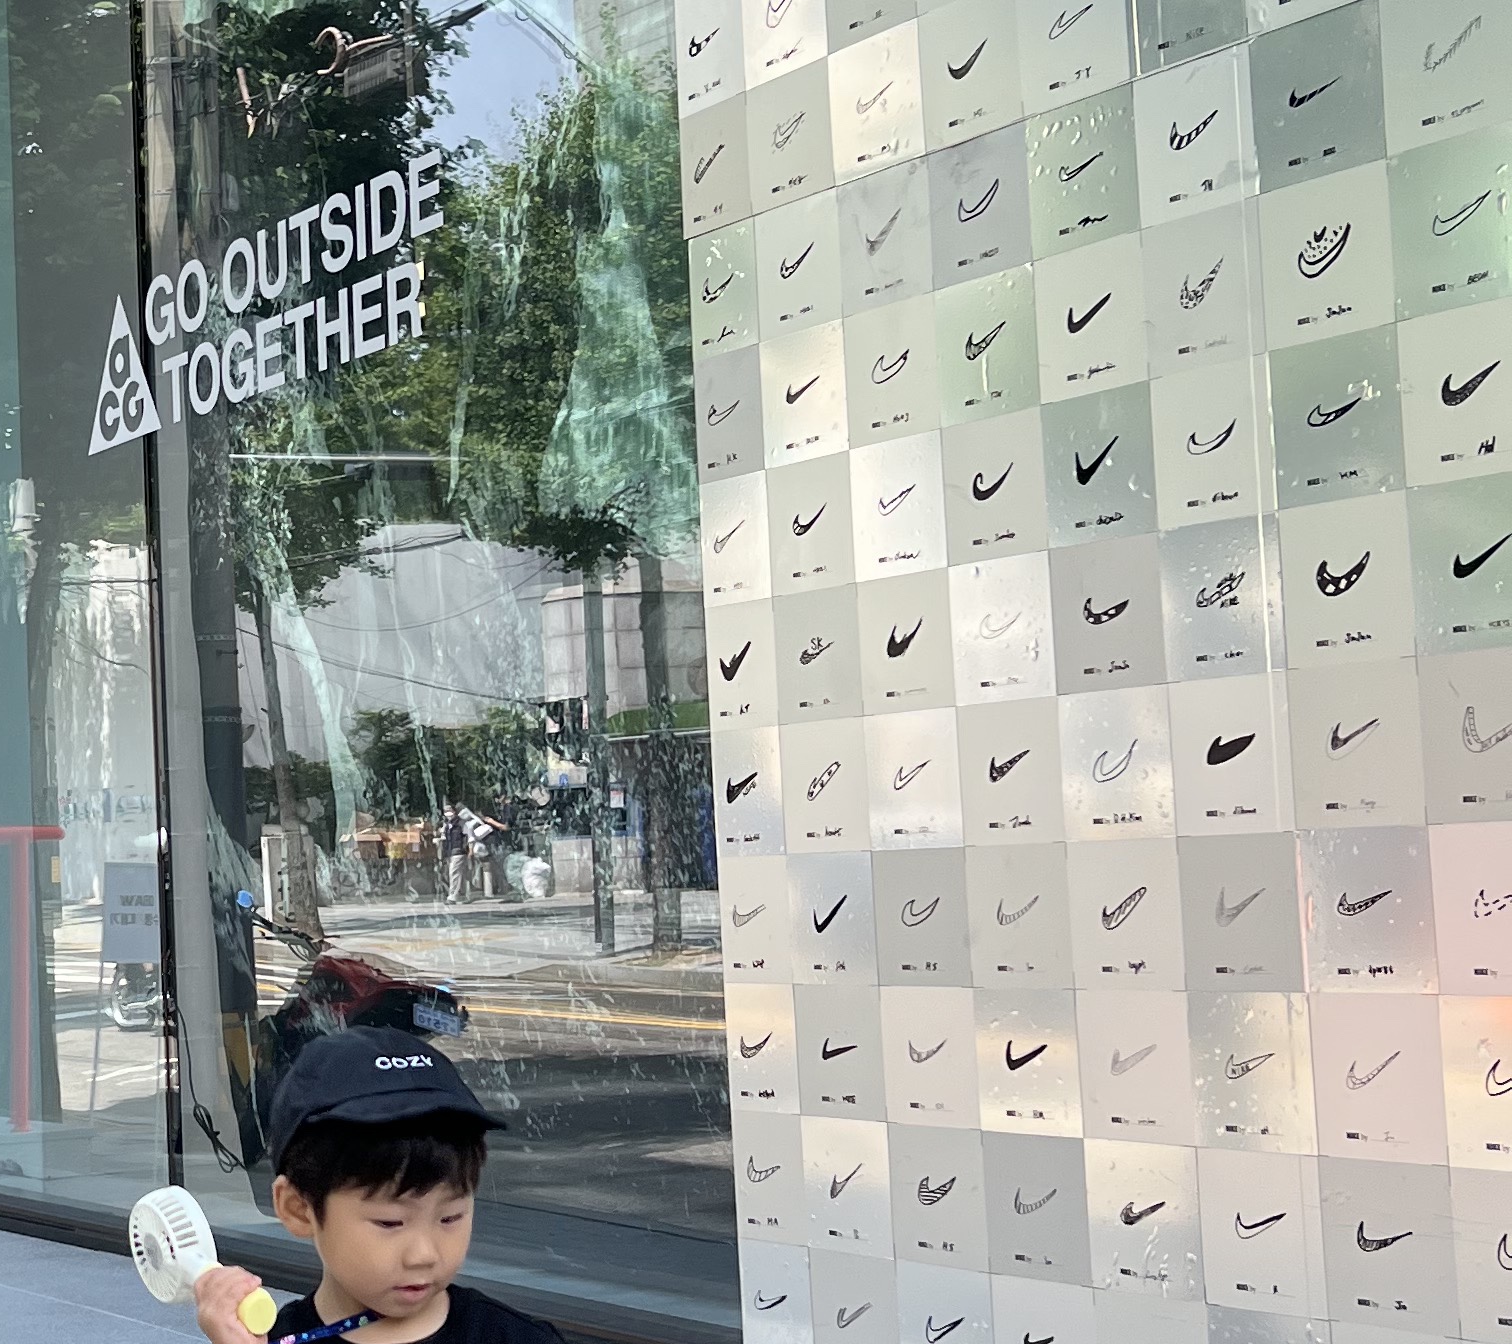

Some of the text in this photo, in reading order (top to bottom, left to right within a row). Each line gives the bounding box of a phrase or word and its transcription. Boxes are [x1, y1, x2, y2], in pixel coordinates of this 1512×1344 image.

[145, 149, 445, 346] GO OUTSIDE
[161, 261, 425, 425] TOGETHER
[375, 1054, 434, 1071] COZY
